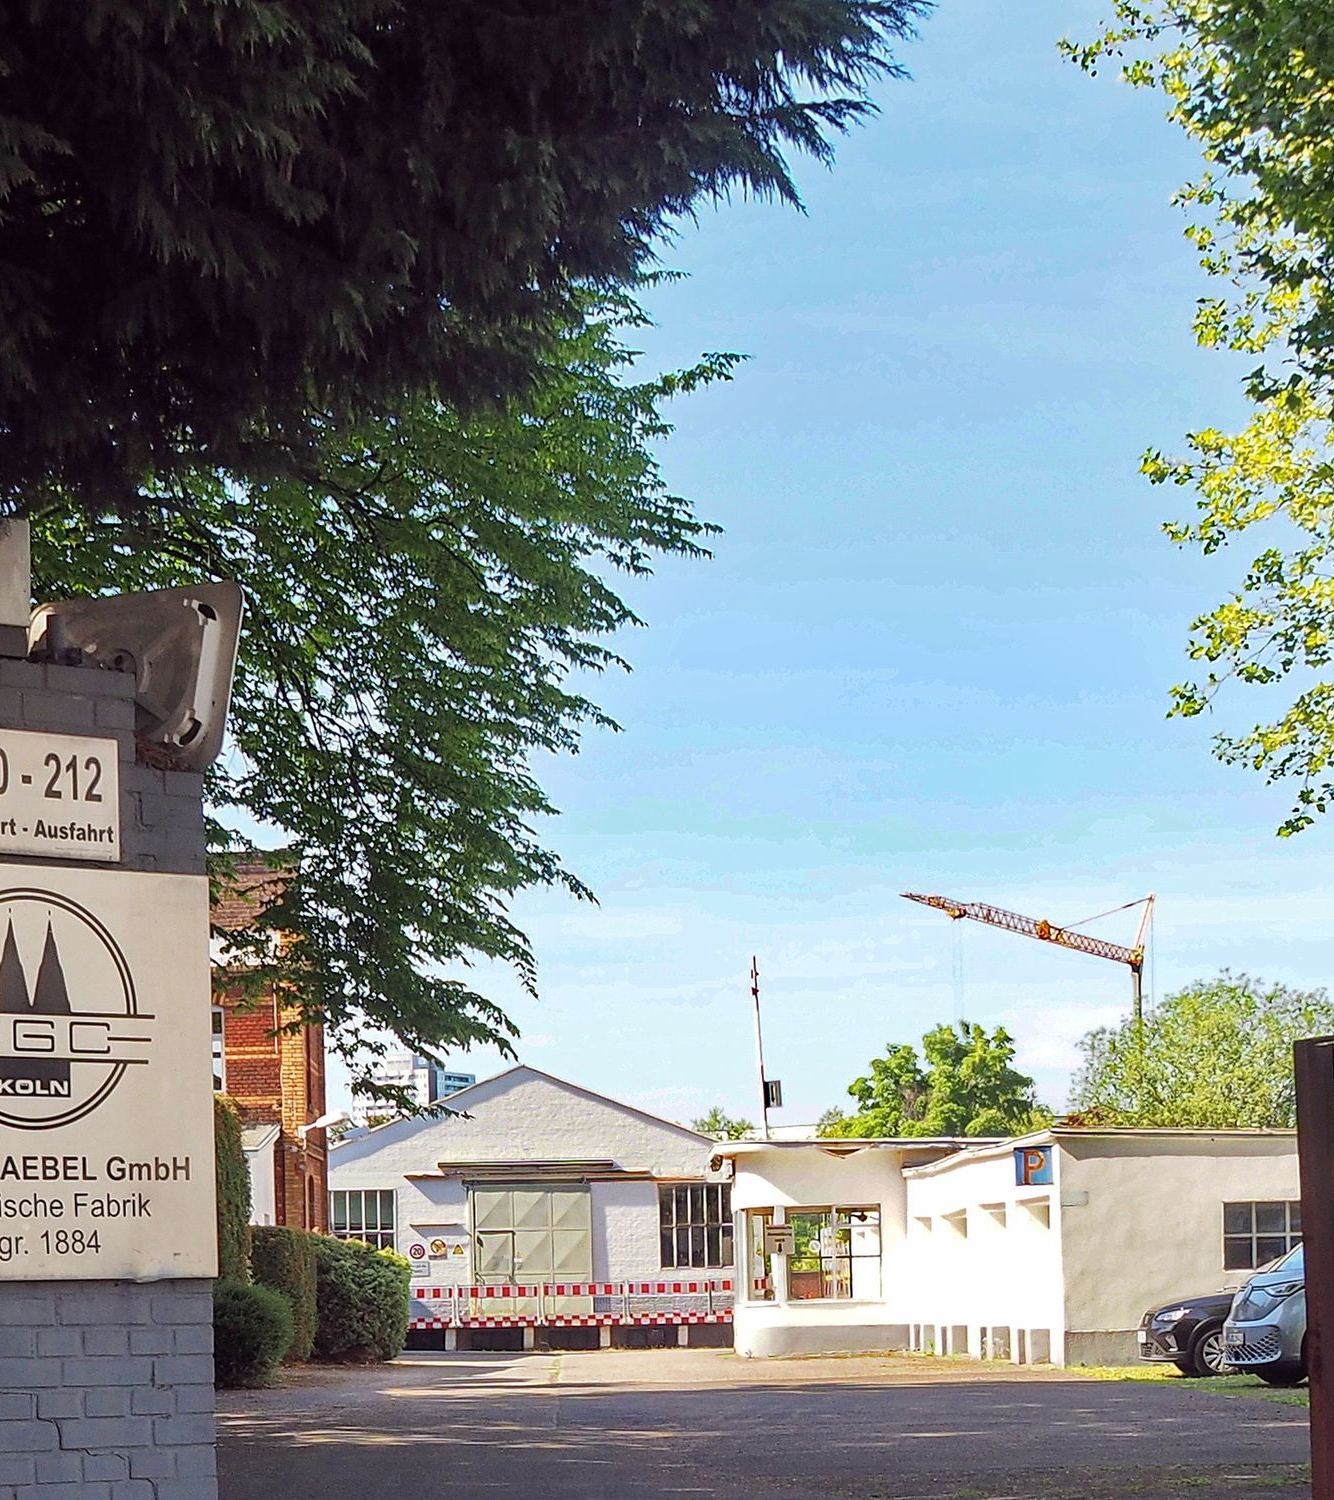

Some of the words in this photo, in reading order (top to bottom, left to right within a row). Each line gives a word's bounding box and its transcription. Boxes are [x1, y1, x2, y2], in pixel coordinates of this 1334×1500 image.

[43, 752, 103, 803] 212
[34, 818, 114, 844] Ausfahrt
[106, 1155, 191, 1182] GmbH
[1024, 1150, 1045, 1185] P
[73, 1192, 152, 1218] Fabrik
[40, 1229, 101, 1255] 1884
[412, 1247, 422, 1256] 20
